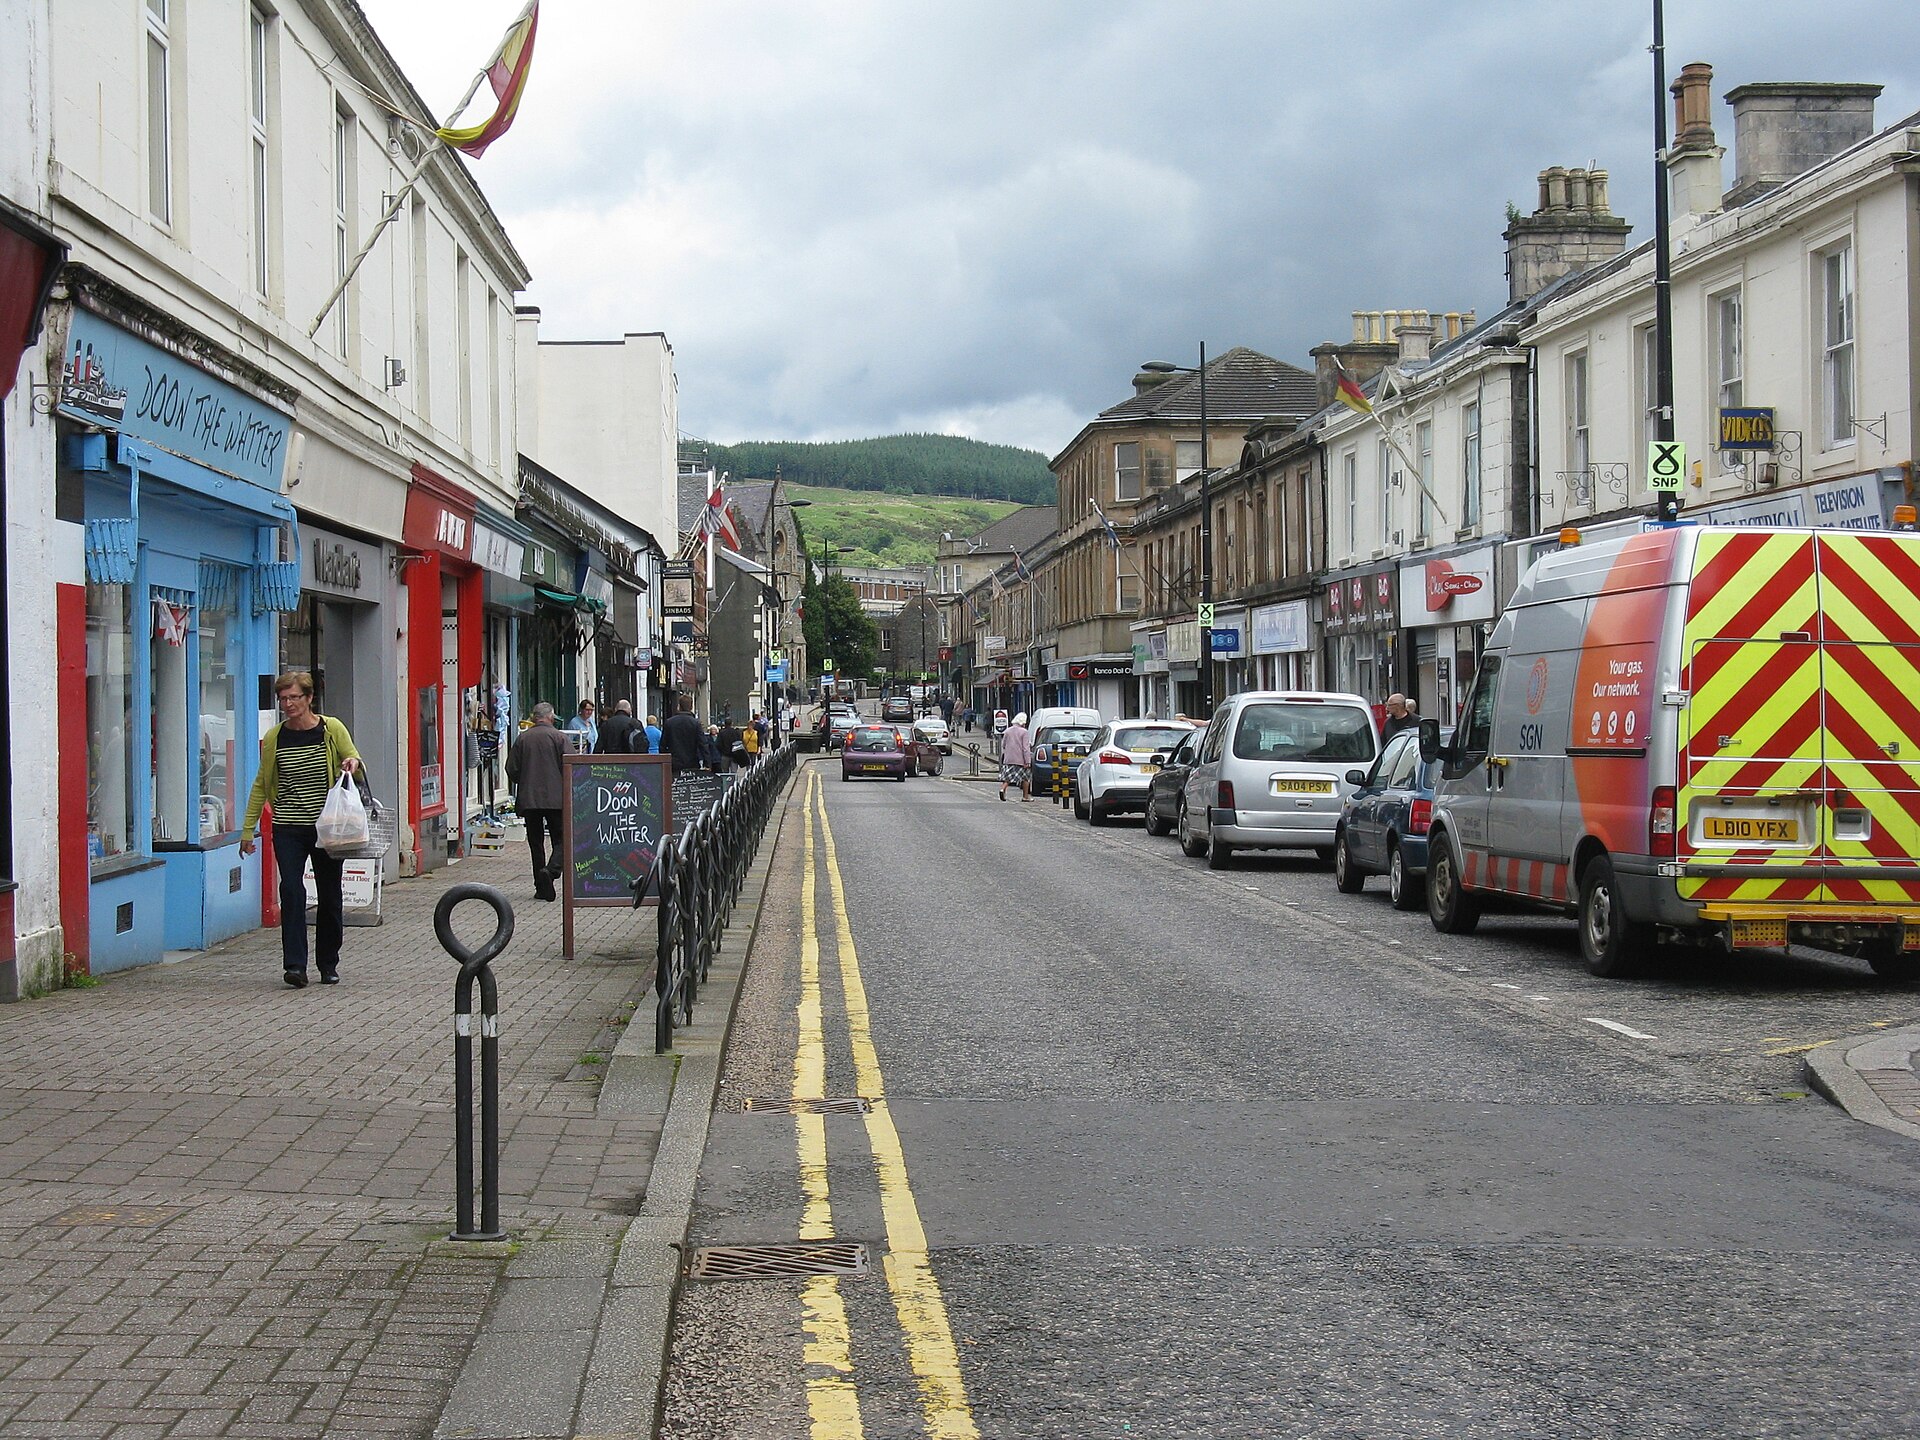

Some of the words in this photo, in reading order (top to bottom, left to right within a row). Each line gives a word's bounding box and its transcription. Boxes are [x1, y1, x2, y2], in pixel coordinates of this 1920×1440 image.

[136, 365, 193, 432] DOON
[193, 394, 226, 451] THE
[224, 411, 282, 475] WATTER
[1722, 416, 1773, 442] VIDEOS
[1652, 477, 1678, 488] SNP
[1814, 486, 1865, 514] TELEVISION
[1644, 523, 1664, 533] Gary
[1444, 580, 1481, 590] Semi-Chem
[1609, 659, 1626, 675] Your
[1627, 661, 1643, 677] gas.
[1592, 682, 1607, 697] Our
[1607, 680, 1640, 697] network.
[1519, 724, 1543, 750] SGN
[1280, 781, 1306, 791] SA04
[1308, 782, 1328, 791] PSX
[608, 811, 637, 826] THE
[596, 823, 655, 846] WATTER
[1713, 820, 1751, 836] LD10
[1755, 821, 1788, 837] YFX
